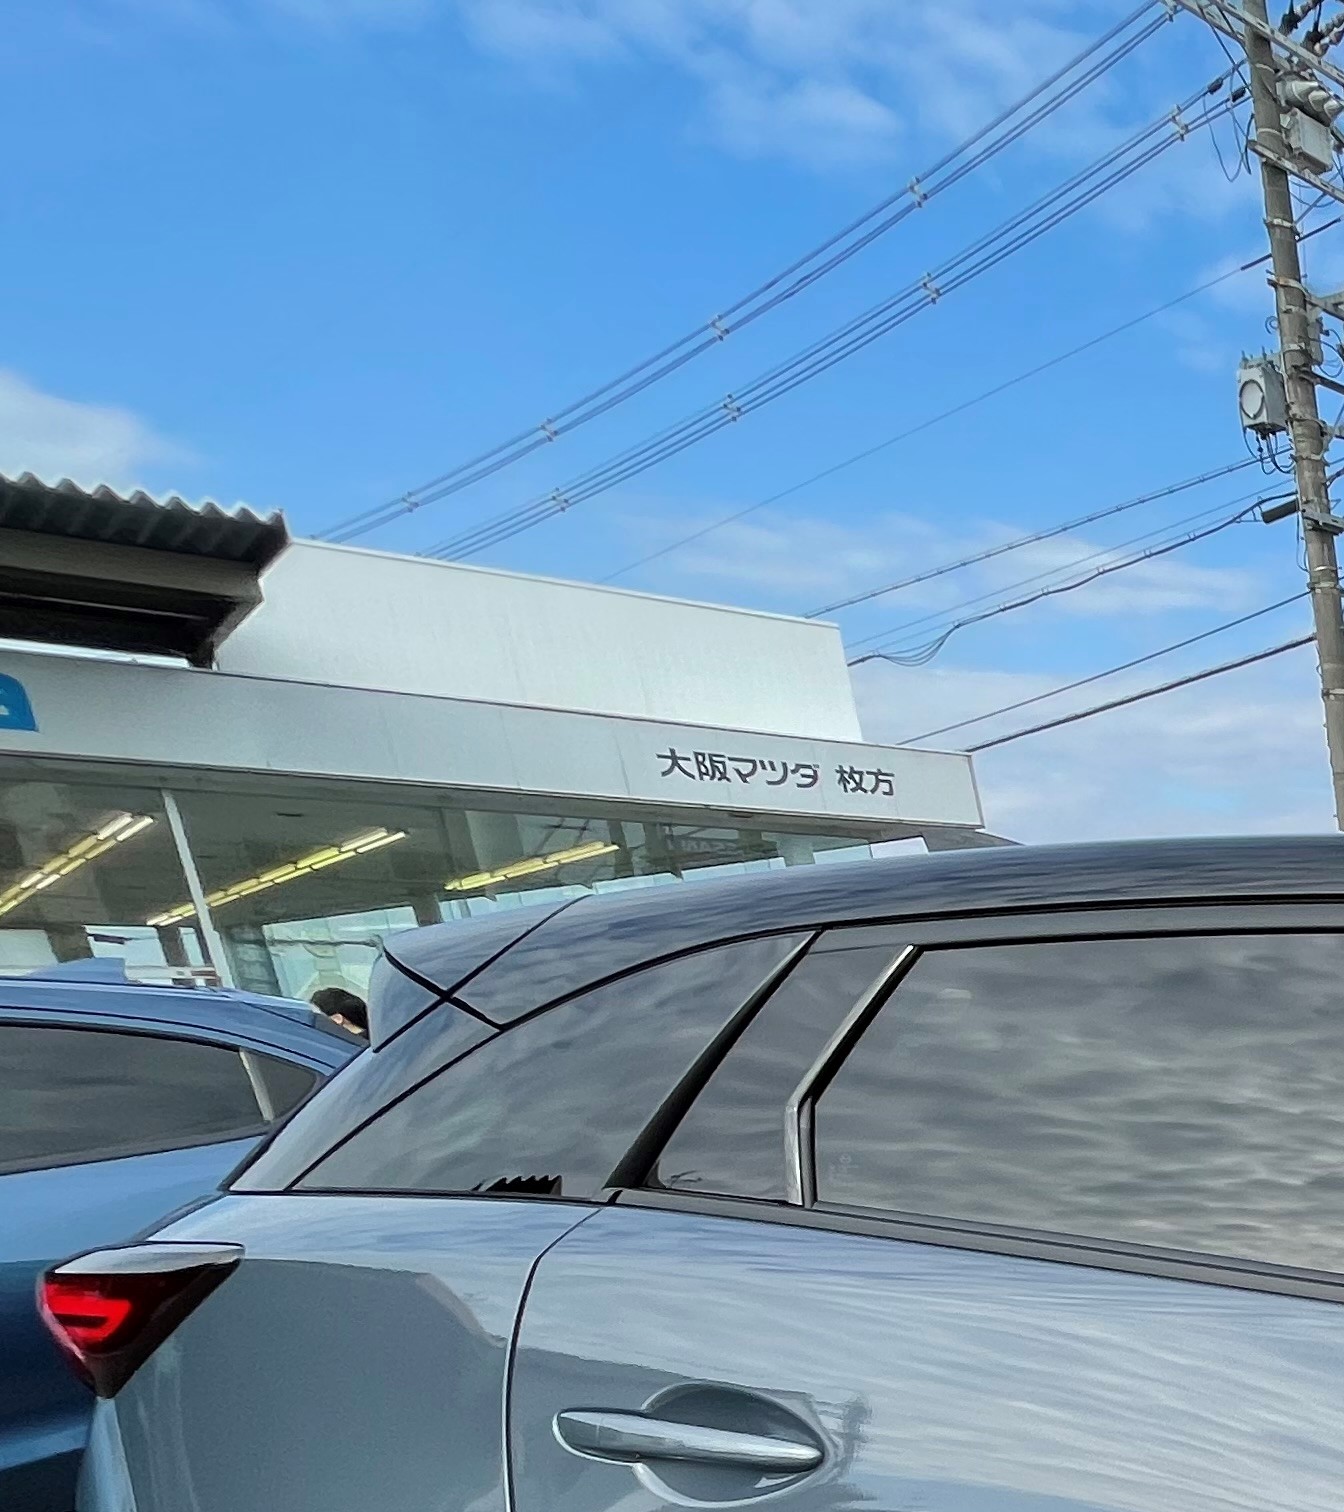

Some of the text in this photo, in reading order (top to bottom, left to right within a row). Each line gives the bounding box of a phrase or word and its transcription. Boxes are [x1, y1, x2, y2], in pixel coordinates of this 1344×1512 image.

[656, 747, 895, 796] 大阪マツダ 枚方
